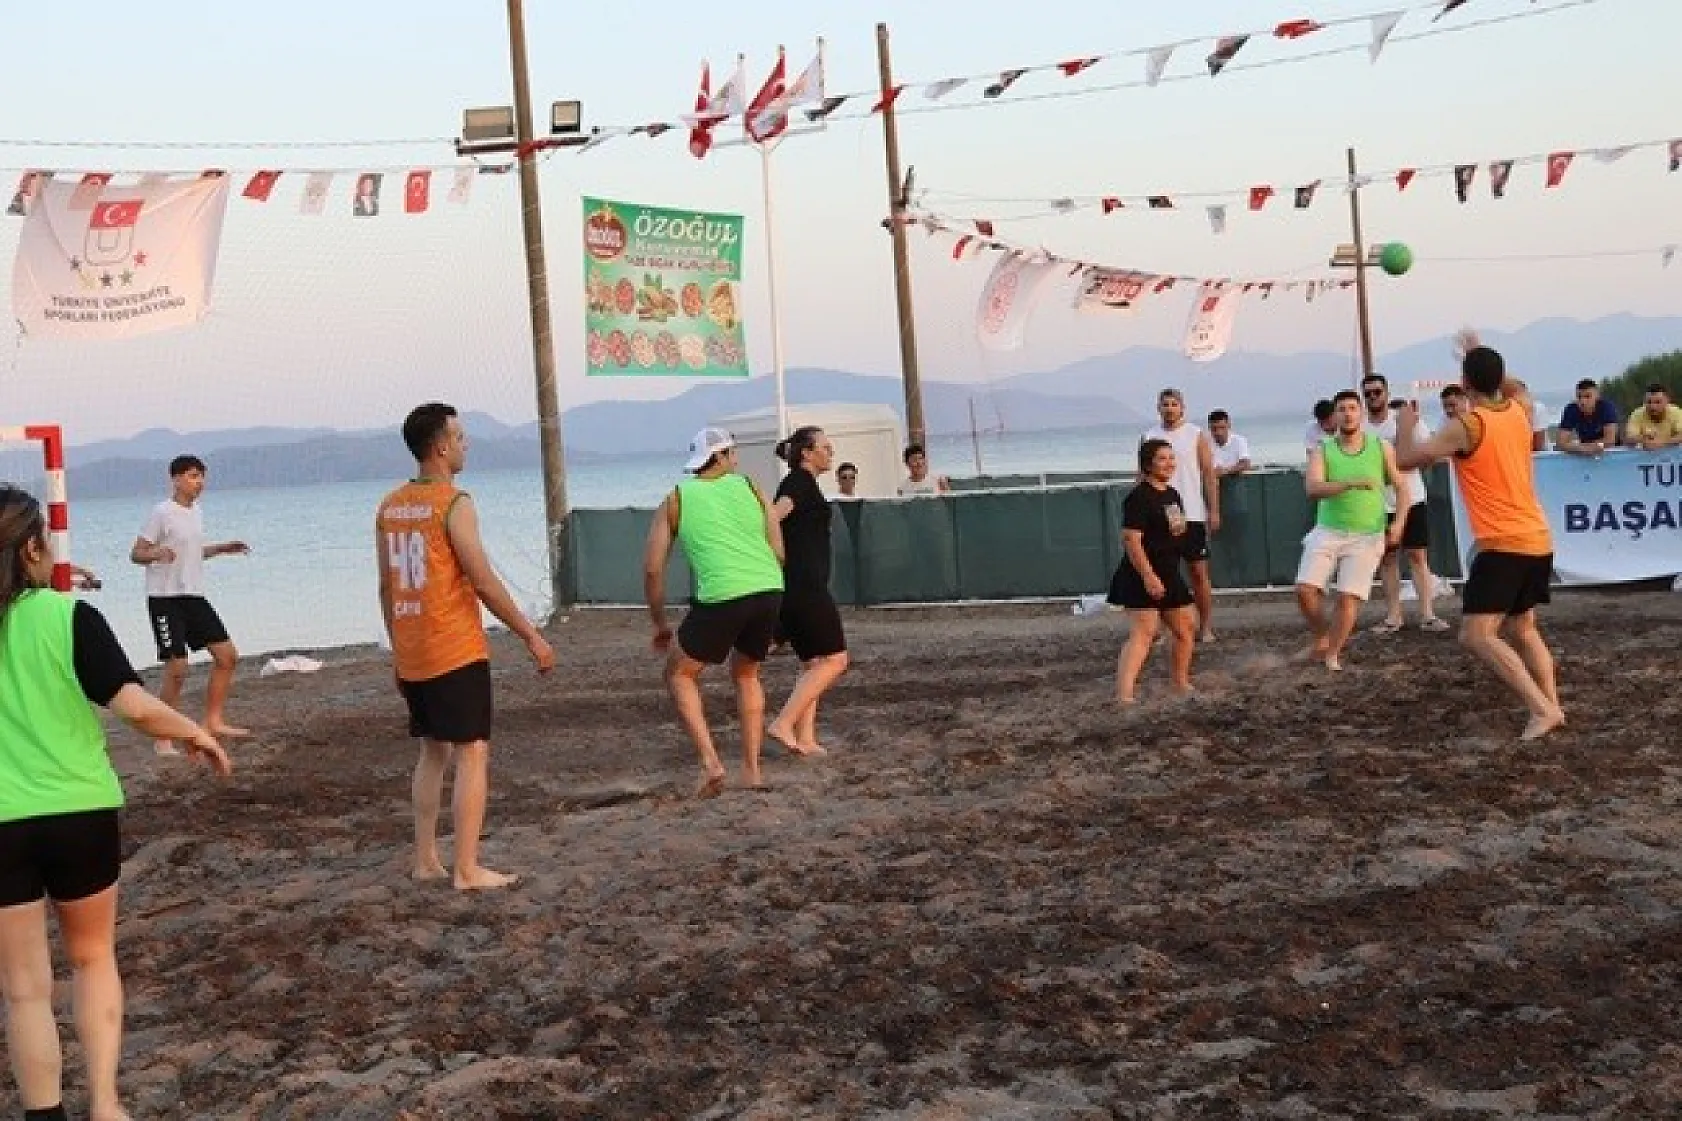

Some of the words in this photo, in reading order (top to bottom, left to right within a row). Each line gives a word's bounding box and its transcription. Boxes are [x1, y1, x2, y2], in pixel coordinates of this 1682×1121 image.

[634, 209, 738, 245] ÖZOĞUL
[1638, 456, 1682, 488] TÜ
[1564, 501, 1682, 541] BAŞA
[387, 532, 427, 589] 48
